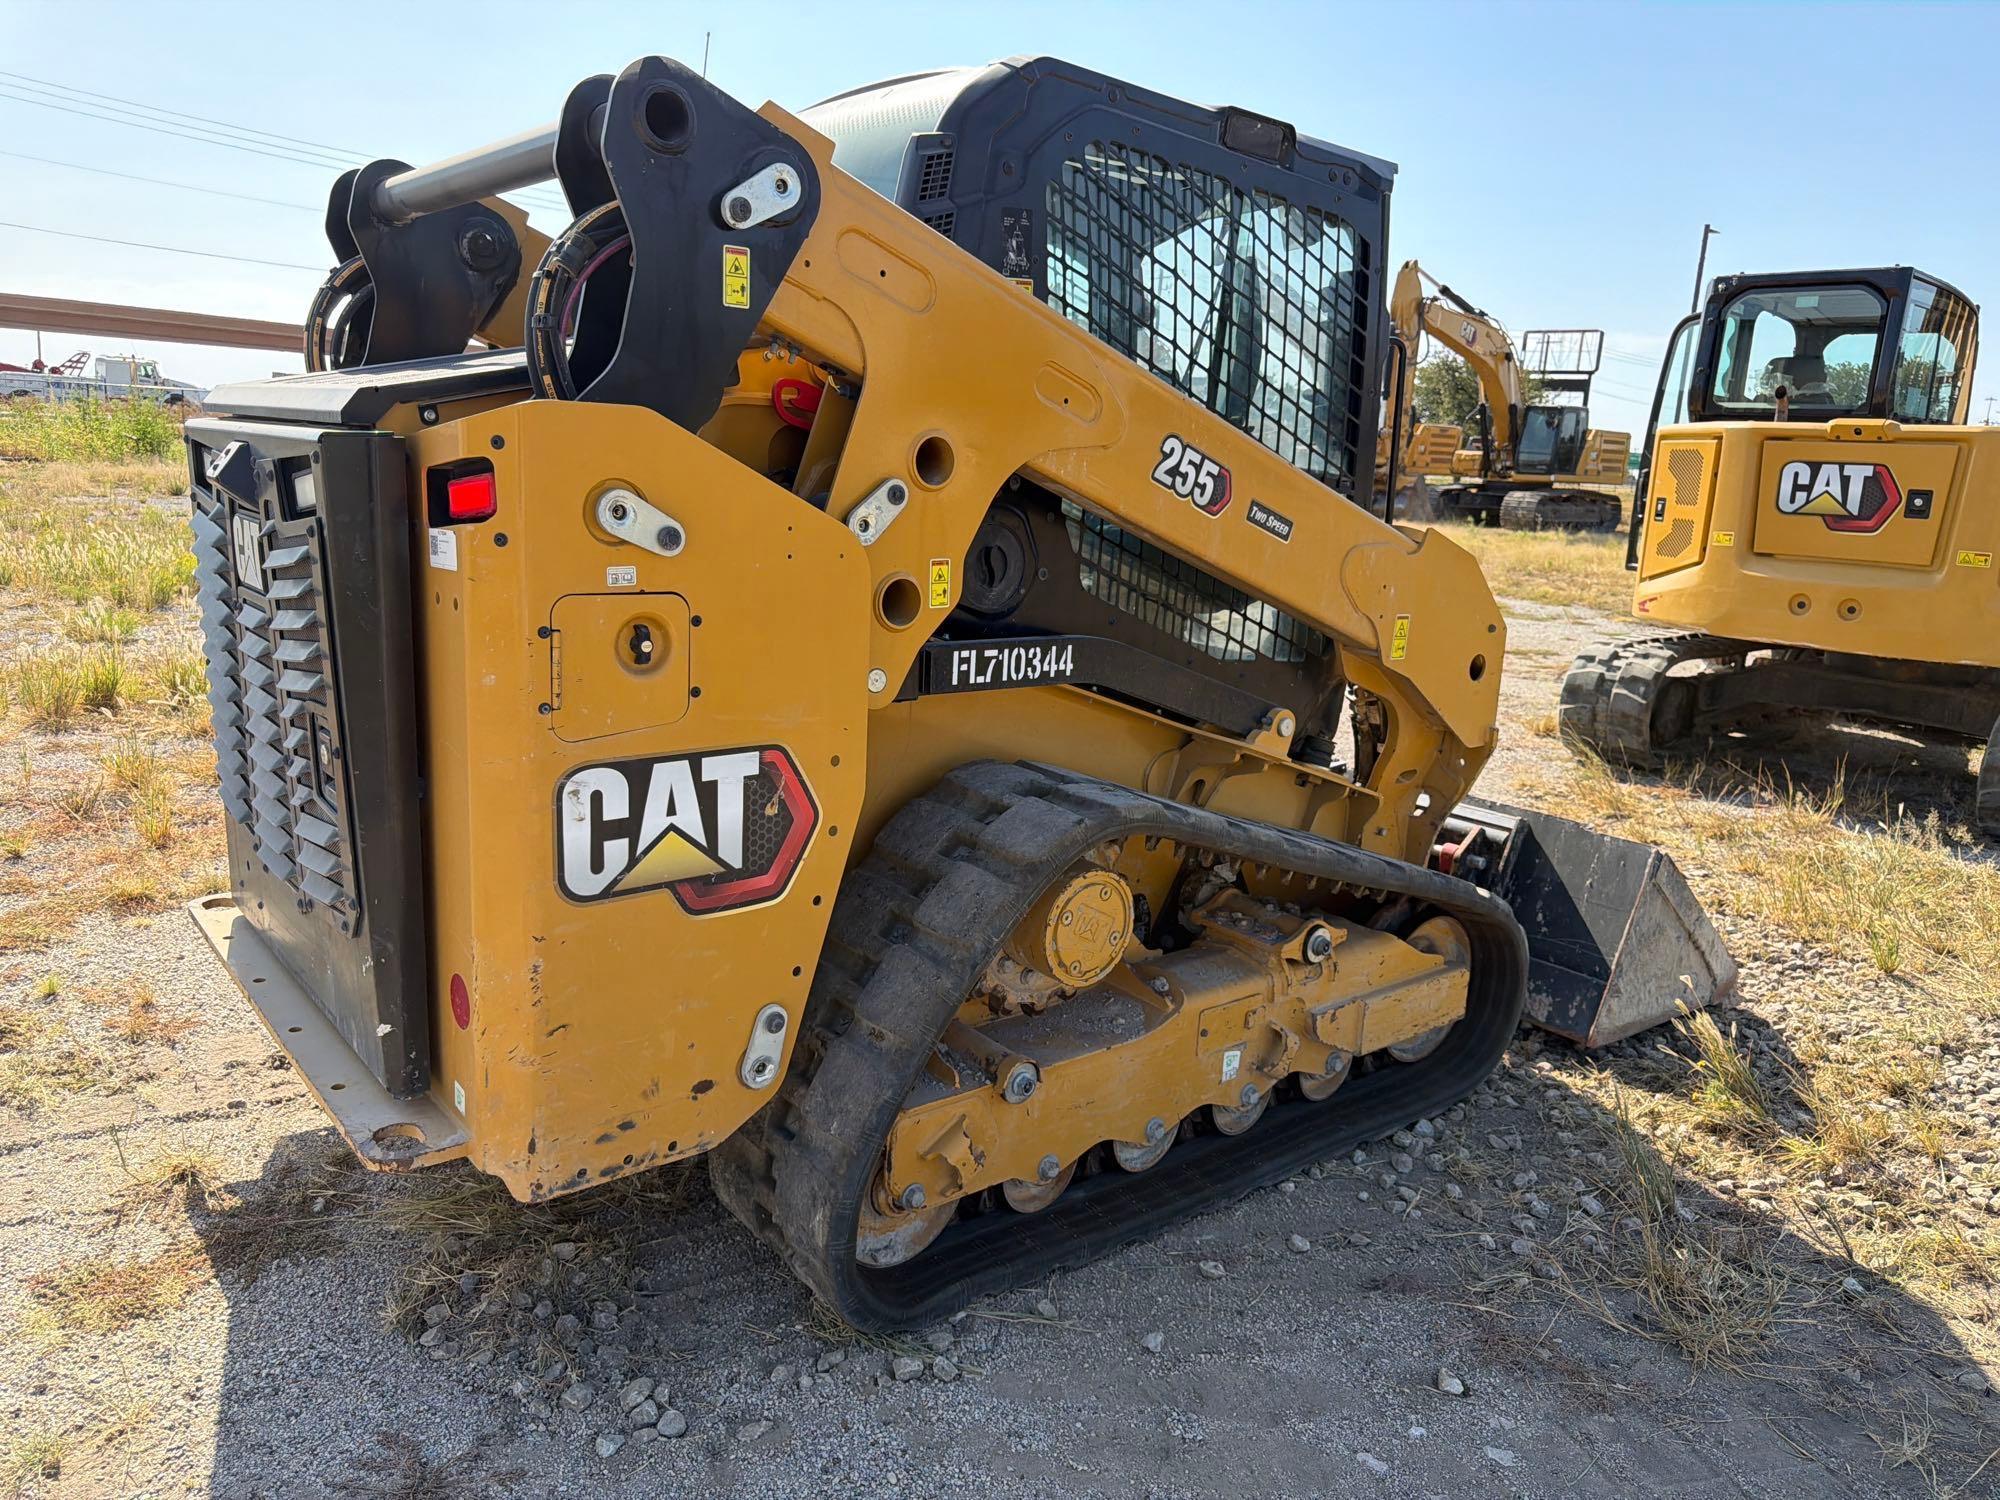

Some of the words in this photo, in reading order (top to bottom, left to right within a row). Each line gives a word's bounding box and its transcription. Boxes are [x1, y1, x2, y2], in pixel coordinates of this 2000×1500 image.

[1461, 321, 1475, 342] CAT
[1153, 437, 1220, 506] 255
[1778, 462, 1874, 516] CAT
[233, 515, 264, 590] CAT
[952, 644, 1073, 686] FL710344
[562, 751, 760, 896] CAT
